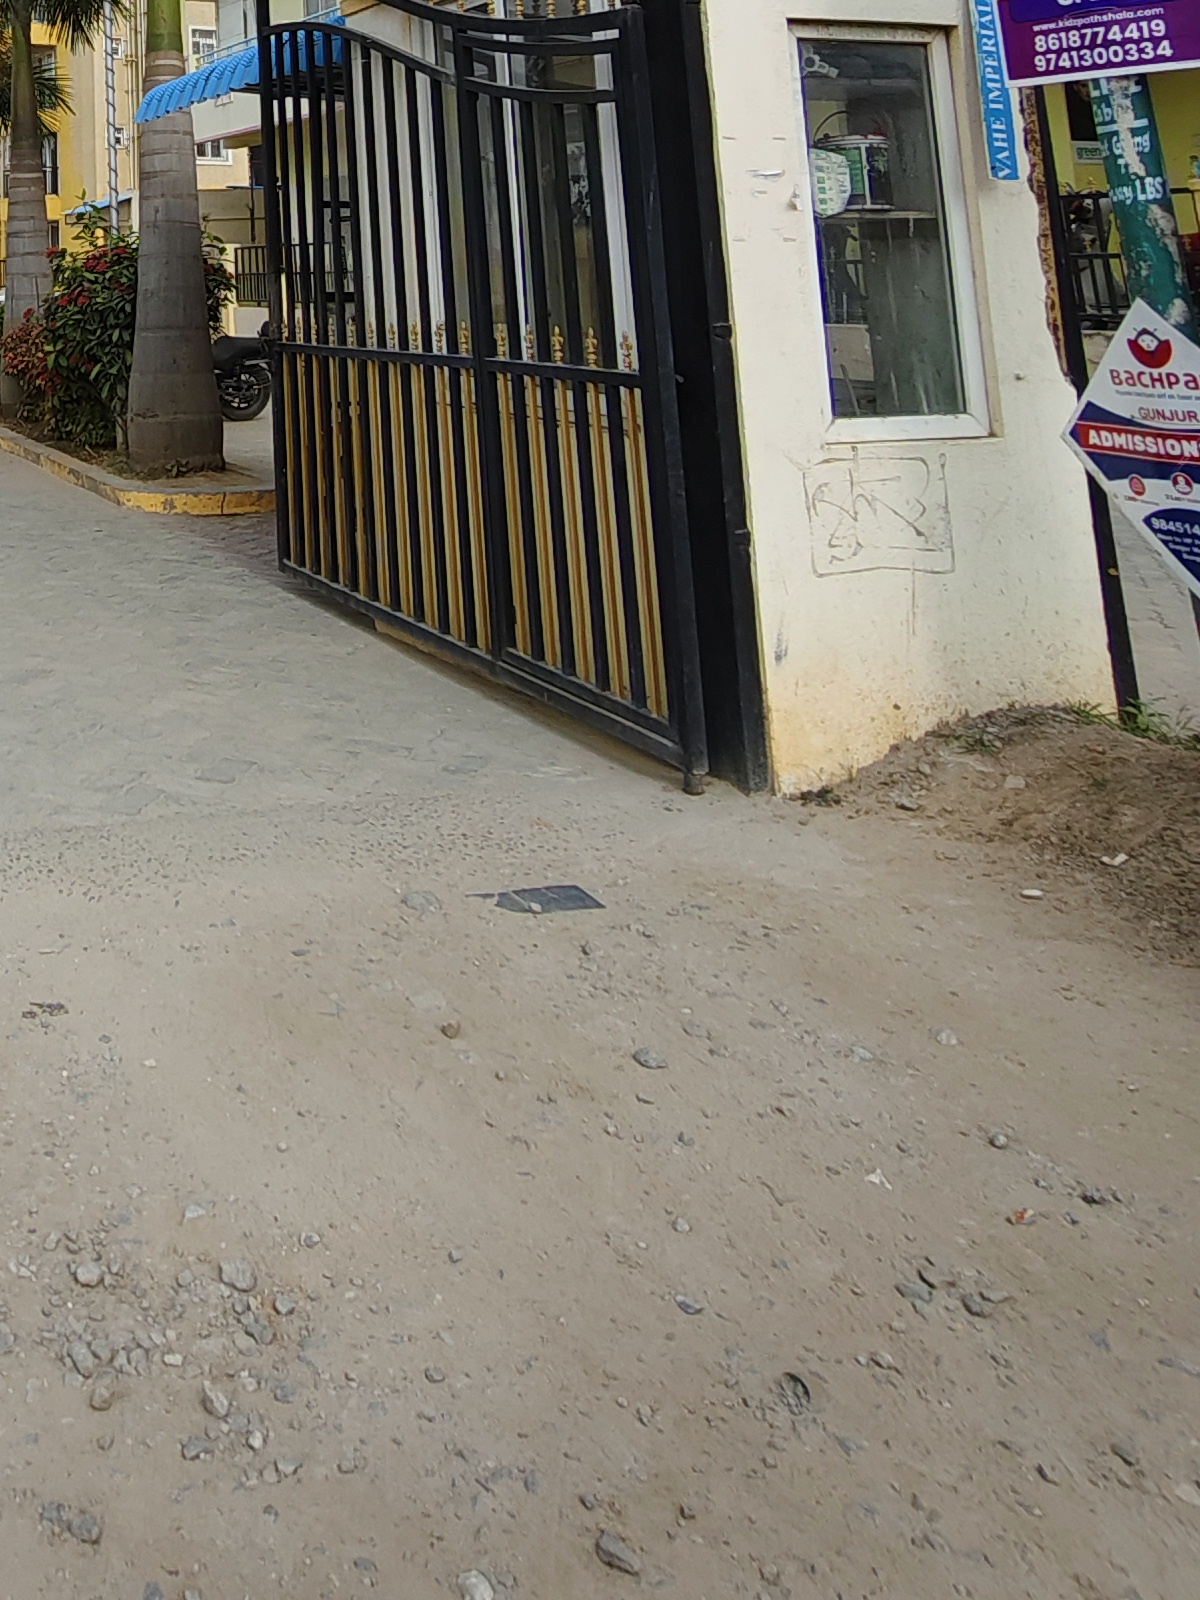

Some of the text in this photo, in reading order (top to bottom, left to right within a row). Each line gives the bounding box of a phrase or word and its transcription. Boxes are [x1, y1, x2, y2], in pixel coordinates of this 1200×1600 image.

[1033, 20, 1166, 53] 8618774419
[1033, 40, 1174, 72] 9741300334
[989, 116, 1012, 180] VAHE
[1137, 406, 1200, 424] GUNJUR
[1088, 429, 1200, 458] ADMISSION
